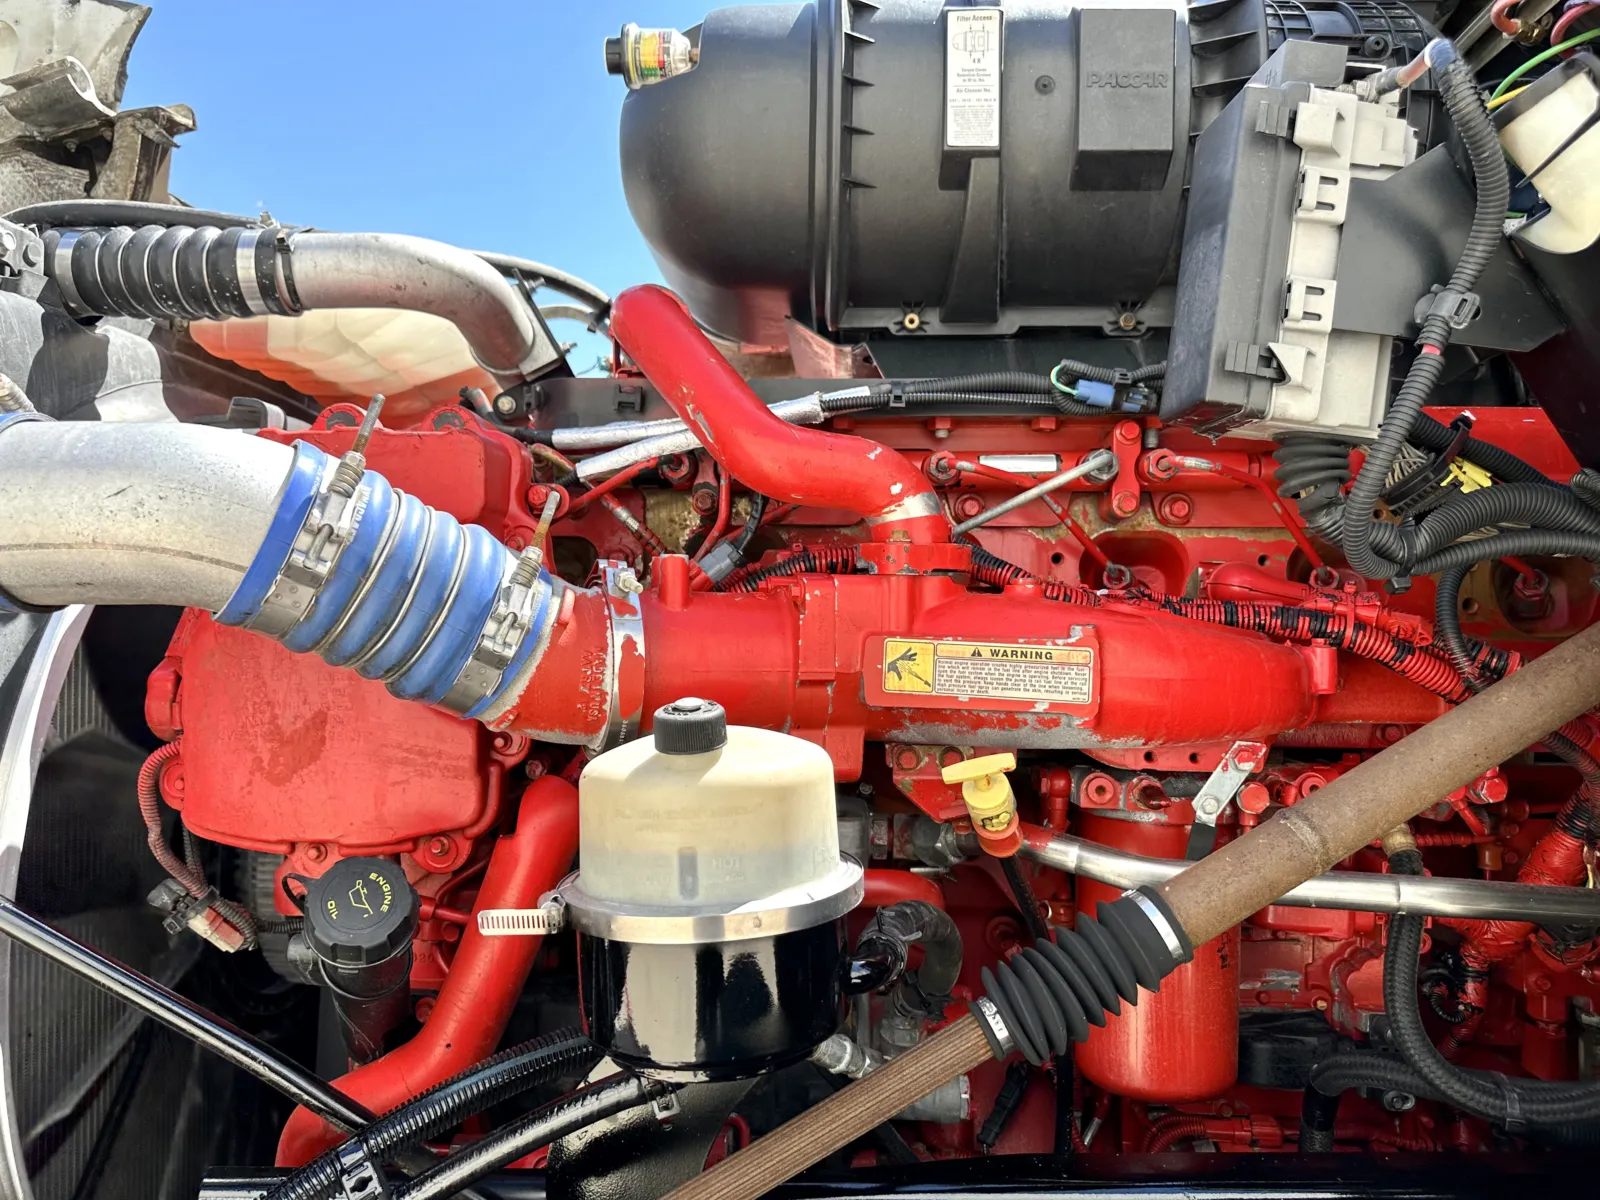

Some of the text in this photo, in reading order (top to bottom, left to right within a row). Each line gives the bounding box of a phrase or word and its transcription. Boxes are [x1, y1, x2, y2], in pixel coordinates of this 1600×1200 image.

[1086, 71, 1168, 89] PACCAR
[990, 648, 1053, 660] WARNING
[369, 872, 392, 913] ENGINE
[327, 900, 339, 920] OIL
